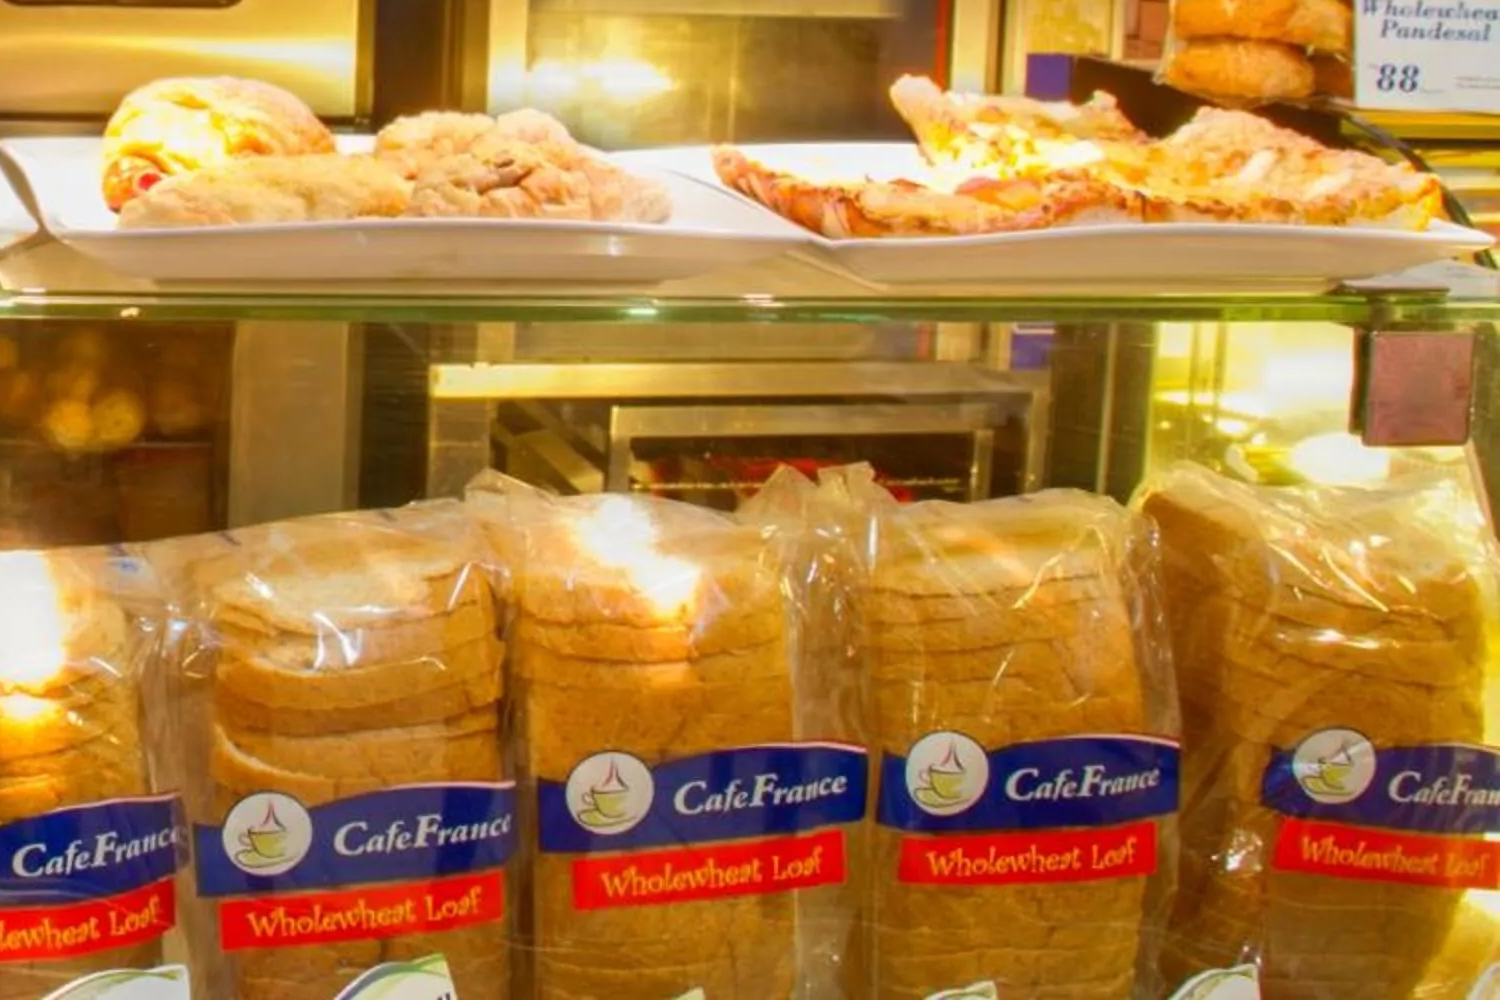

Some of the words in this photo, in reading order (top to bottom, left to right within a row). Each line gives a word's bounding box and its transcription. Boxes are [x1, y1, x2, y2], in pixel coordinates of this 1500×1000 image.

[1381, 19, 1492, 42] Pandesal
[1376, 63, 1420, 93] 88
[673, 774, 848, 816] CafeFrance
[1005, 765, 1160, 803] CafeFrance
[334, 813, 512, 857] CafeFrance
[1301, 834, 1438, 875] Wholewheat
[601, 857, 762, 899] Wholewheat
[772, 845, 824, 882] Loaf
[925, 844, 1082, 878] Wholewheat
[1090, 836, 1138, 871] Loaf
[108, 895, 161, 937] Loaf
[247, 898, 417, 938] Wholewheat
[424, 885, 483, 922] Loaf
